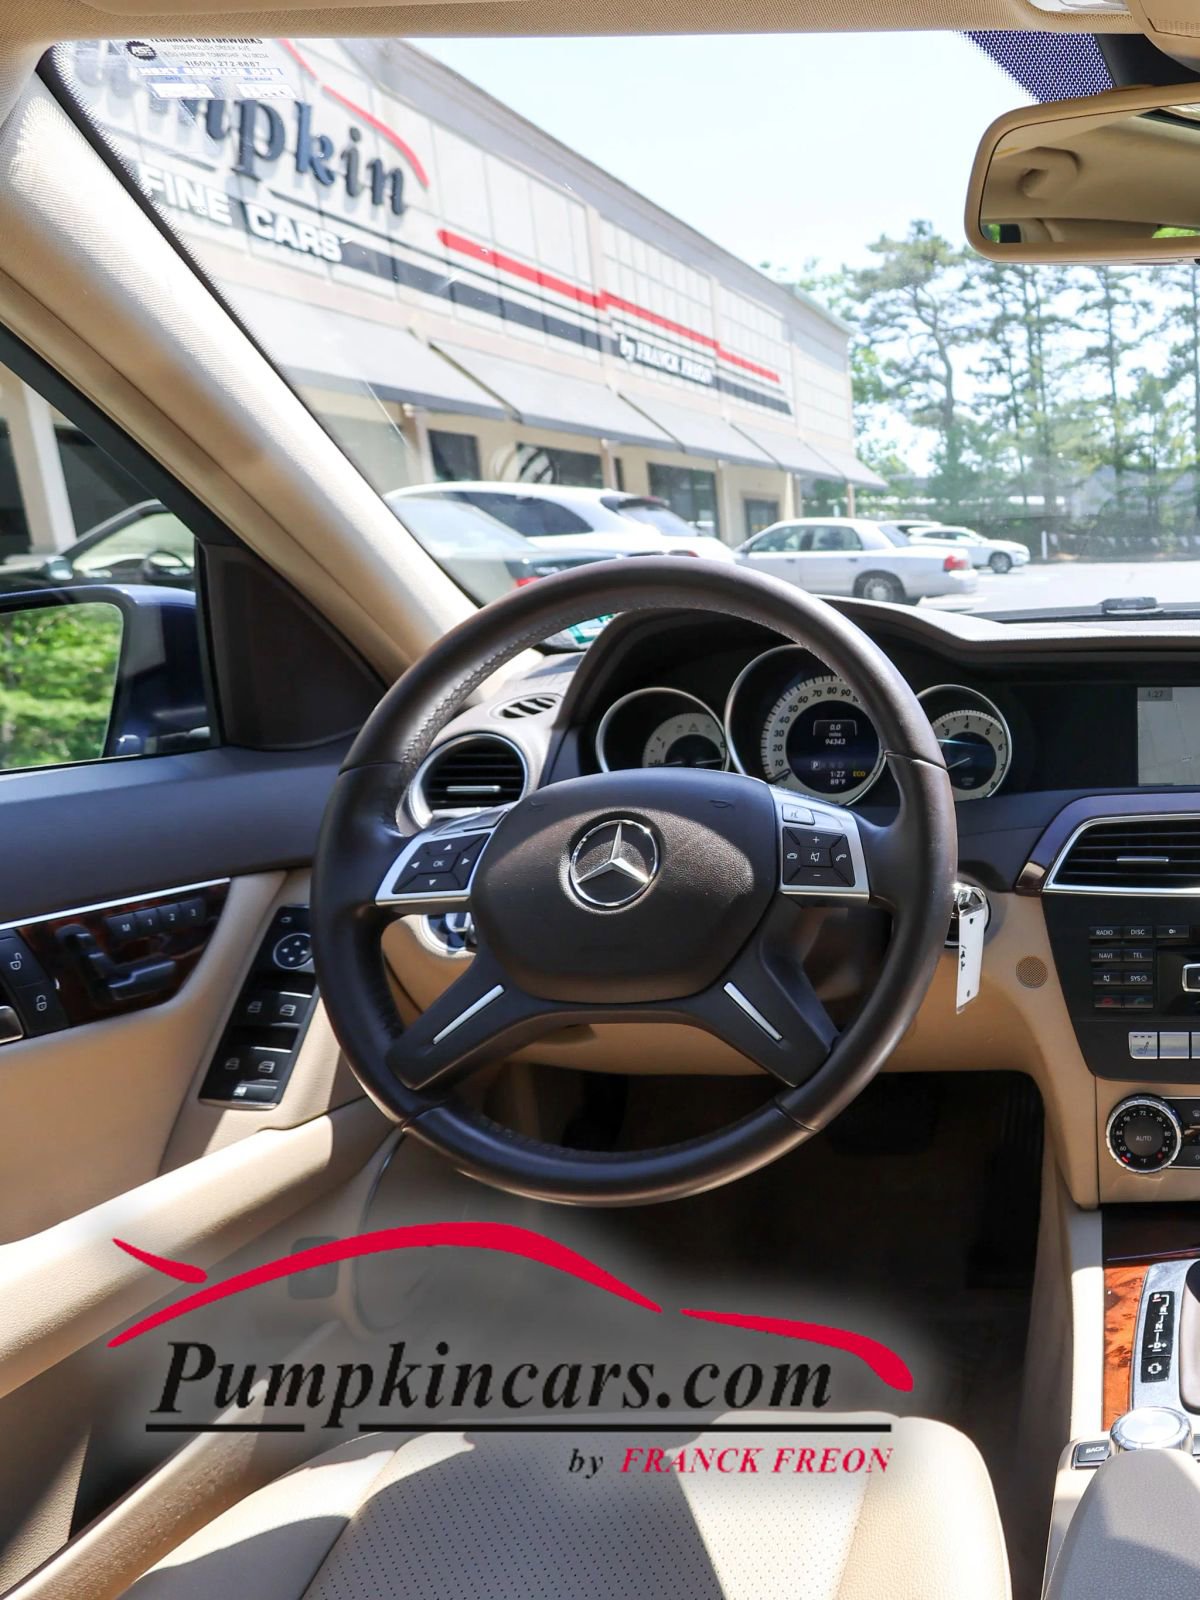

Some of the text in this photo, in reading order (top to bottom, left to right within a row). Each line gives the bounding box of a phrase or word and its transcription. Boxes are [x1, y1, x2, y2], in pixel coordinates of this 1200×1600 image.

[140, 164, 343, 263] FINE CARS
[827, 686, 837, 695] 80
[840, 689, 851, 697] 90
[798, 696, 809, 704] 60
[788, 705, 799, 713] 50
[779, 716, 790, 724] 40
[772, 744, 783, 752] 20
[1086, 1446, 1105, 1454] BACK
